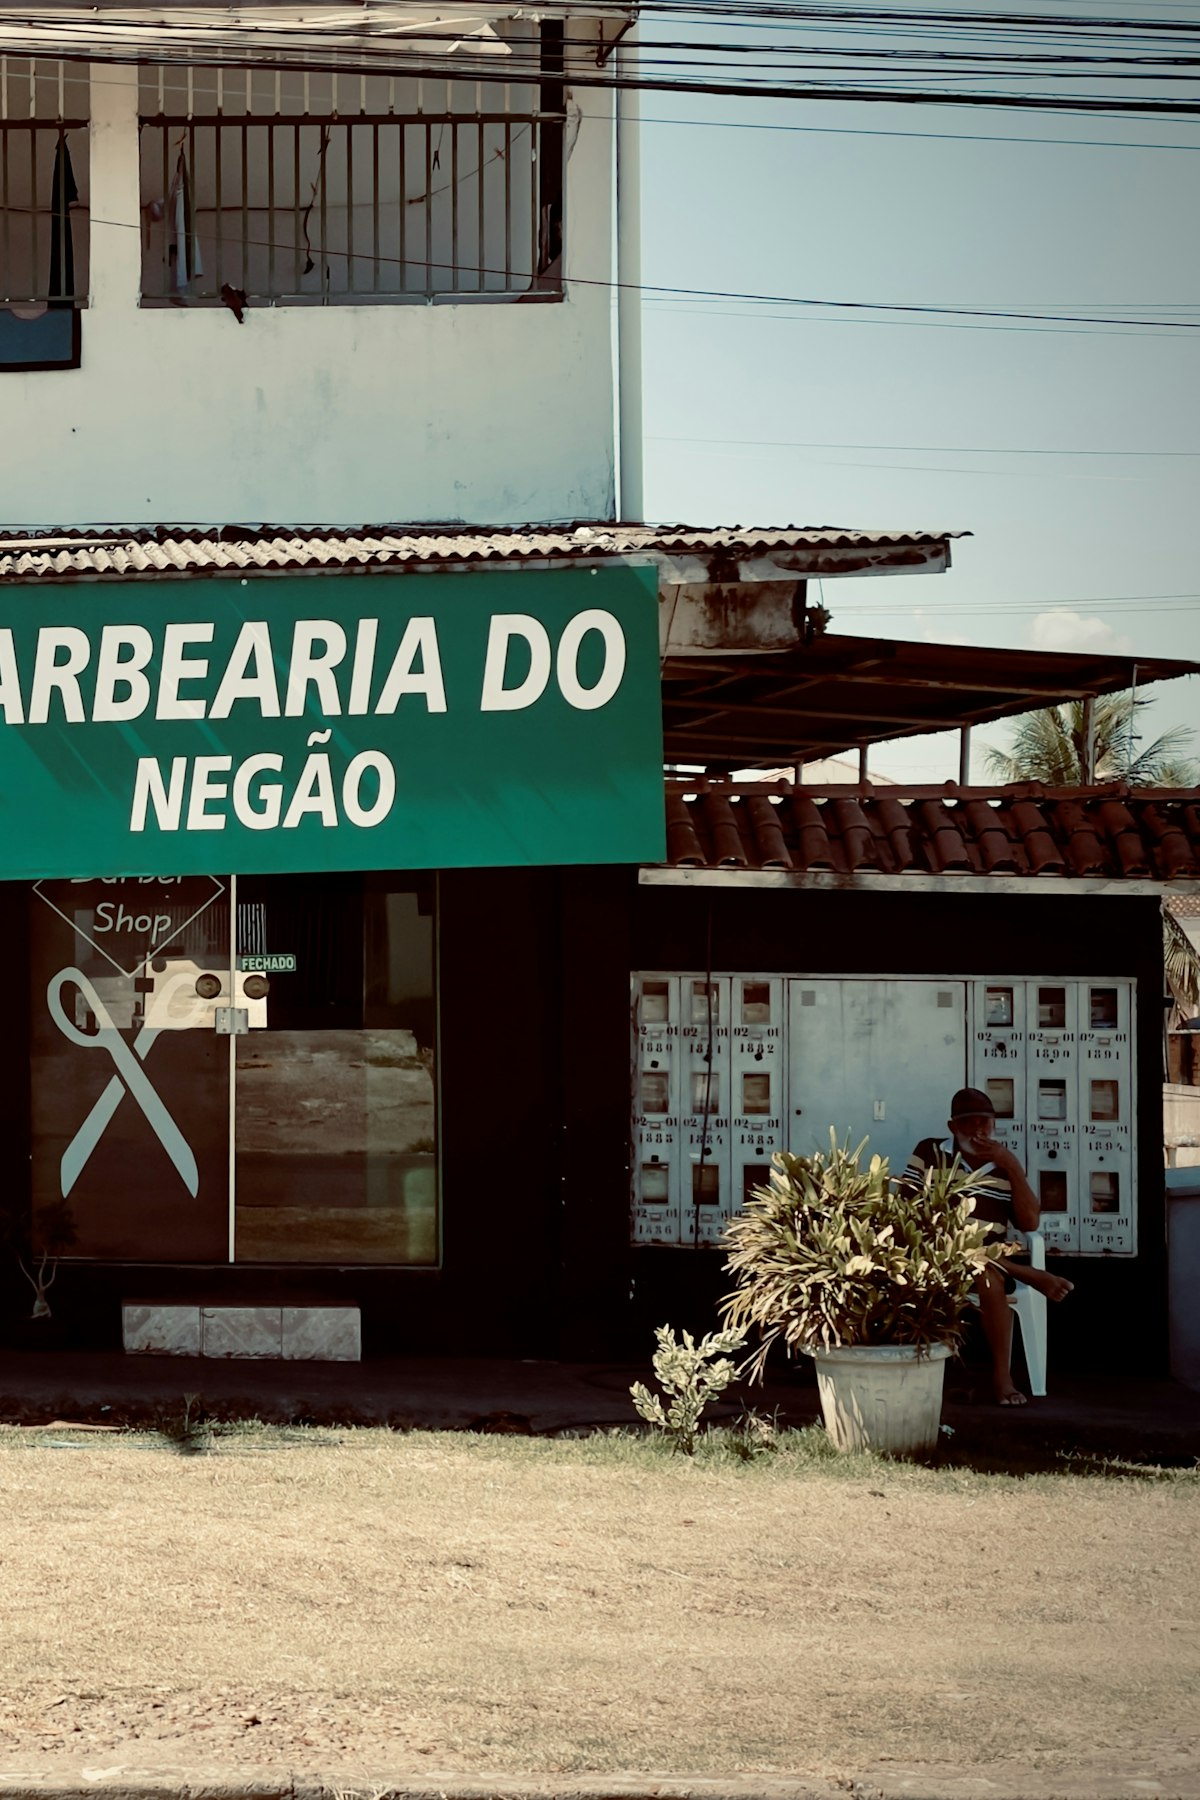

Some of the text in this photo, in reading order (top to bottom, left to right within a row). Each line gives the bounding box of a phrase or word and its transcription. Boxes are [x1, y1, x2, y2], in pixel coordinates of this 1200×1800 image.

[479, 608, 627, 712] DO
[129, 727, 397, 832] NEGÃO
[93, 902, 172, 946] Shop
[241, 956, 295, 971] FECHADO
[734, 1027, 749, 1037] 02
[977, 1032, 992, 1042] 02
[1029, 1032, 1043, 1042] 02
[690, 1043, 721, 1054] 181
[734, 1119, 749, 1129] 02
